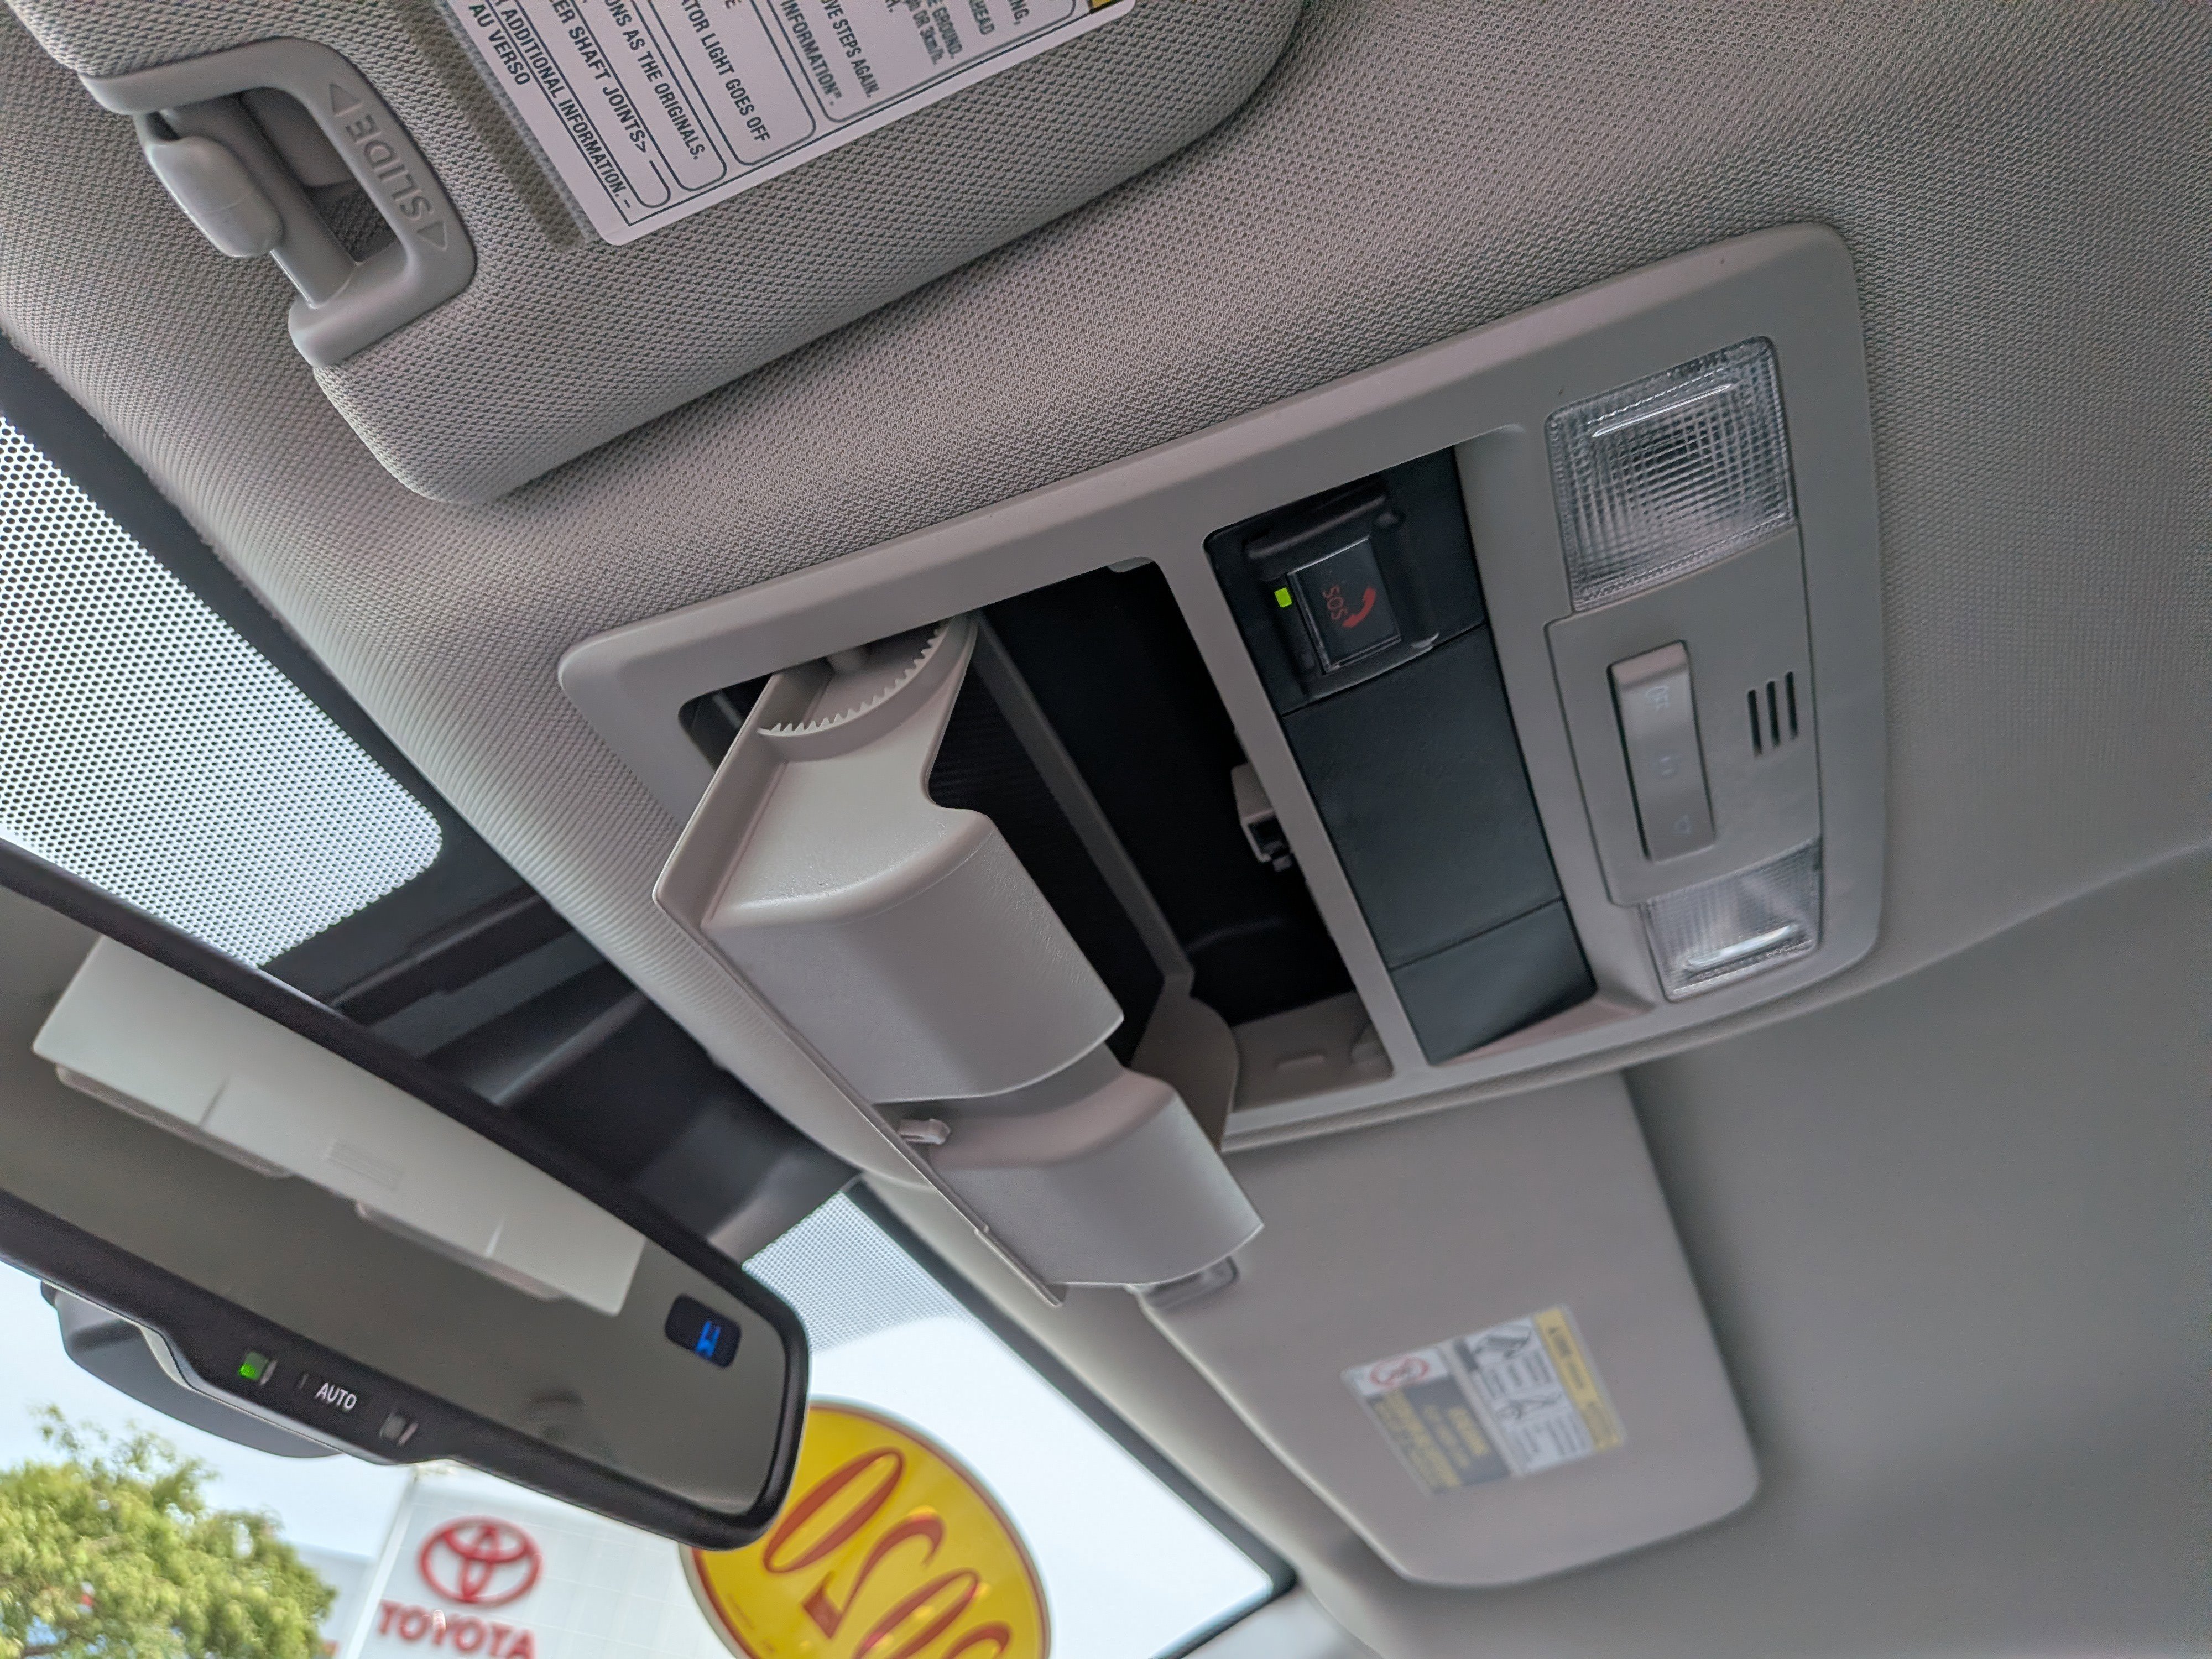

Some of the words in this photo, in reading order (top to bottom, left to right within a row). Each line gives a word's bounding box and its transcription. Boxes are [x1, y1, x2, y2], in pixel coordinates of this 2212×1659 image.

[468, 4, 495, 27] AU
[488, 29, 531, 85] VERSO
[549, 0, 576, 24] ER
[568, 26, 611, 80] SHAFT
[602, 86, 646, 153] JOINTS>
[700, 33, 735, 76] LIGHT
[725, 79, 755, 116] GOES
[747, 117, 770, 142] OFF
[832, 19, 862, 58] STEPS
[851, 58, 880, 98] AGAIN.
[500, 9, 565, 99] ADDITIONAL
[558, 98, 626, 198] INFORMATION.
[622, 29, 646, 51] AS
[637, 50, 664, 82] THE
[654, 82, 705, 160] ORIGINALS.
[344, 114, 435, 221] SLIDE
[1322, 585, 1349, 620] SOS
[315, 1381, 358, 1411] AUTO
[379, 1599, 535, 1659] TOYOTA
